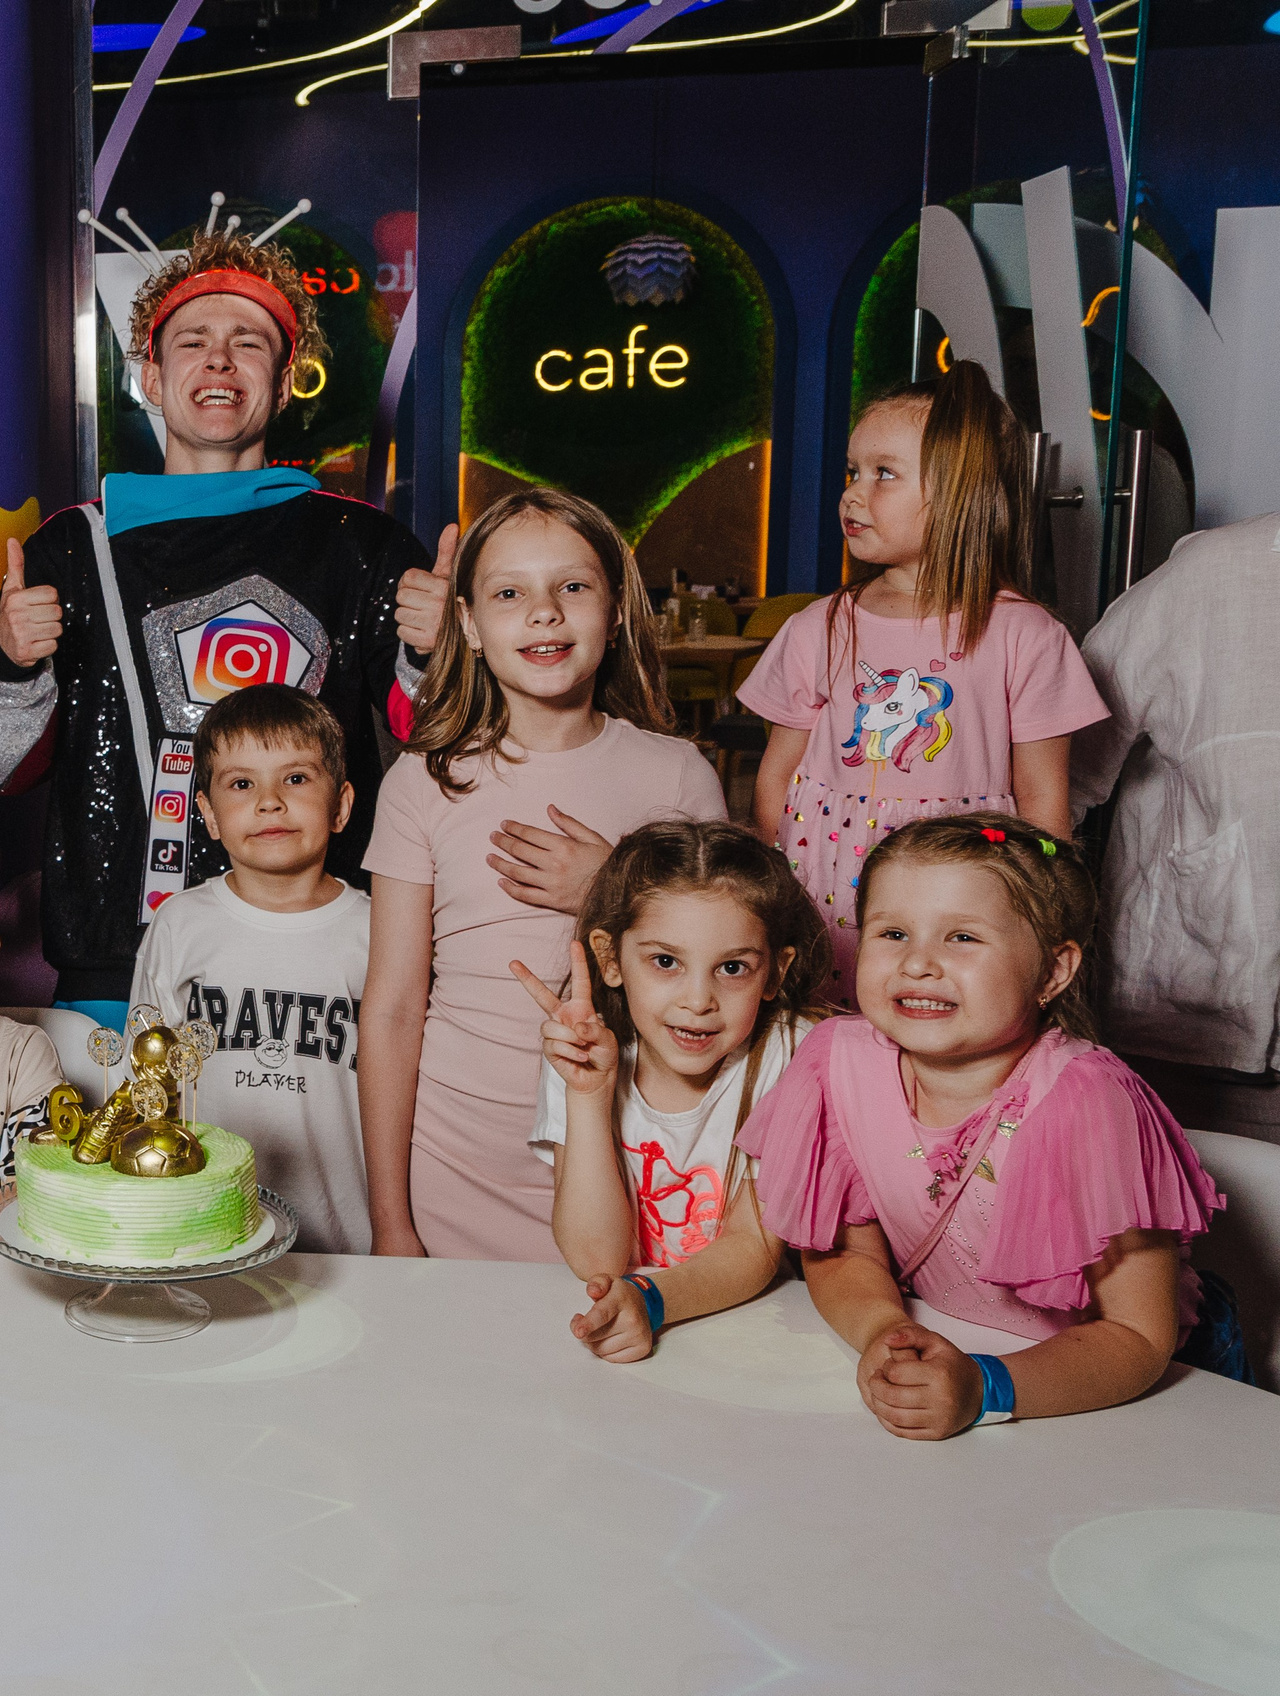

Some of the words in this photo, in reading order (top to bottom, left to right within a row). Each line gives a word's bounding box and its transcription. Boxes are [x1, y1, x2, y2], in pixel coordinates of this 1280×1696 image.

[535, 324, 689, 392] cafe
[171, 740, 190, 754] You
[164, 756, 191, 772] Tube
[154, 863, 179, 872] TikTok
[235, 1069, 307, 1094] PLAYER
[48, 1083, 83, 1141] 6
